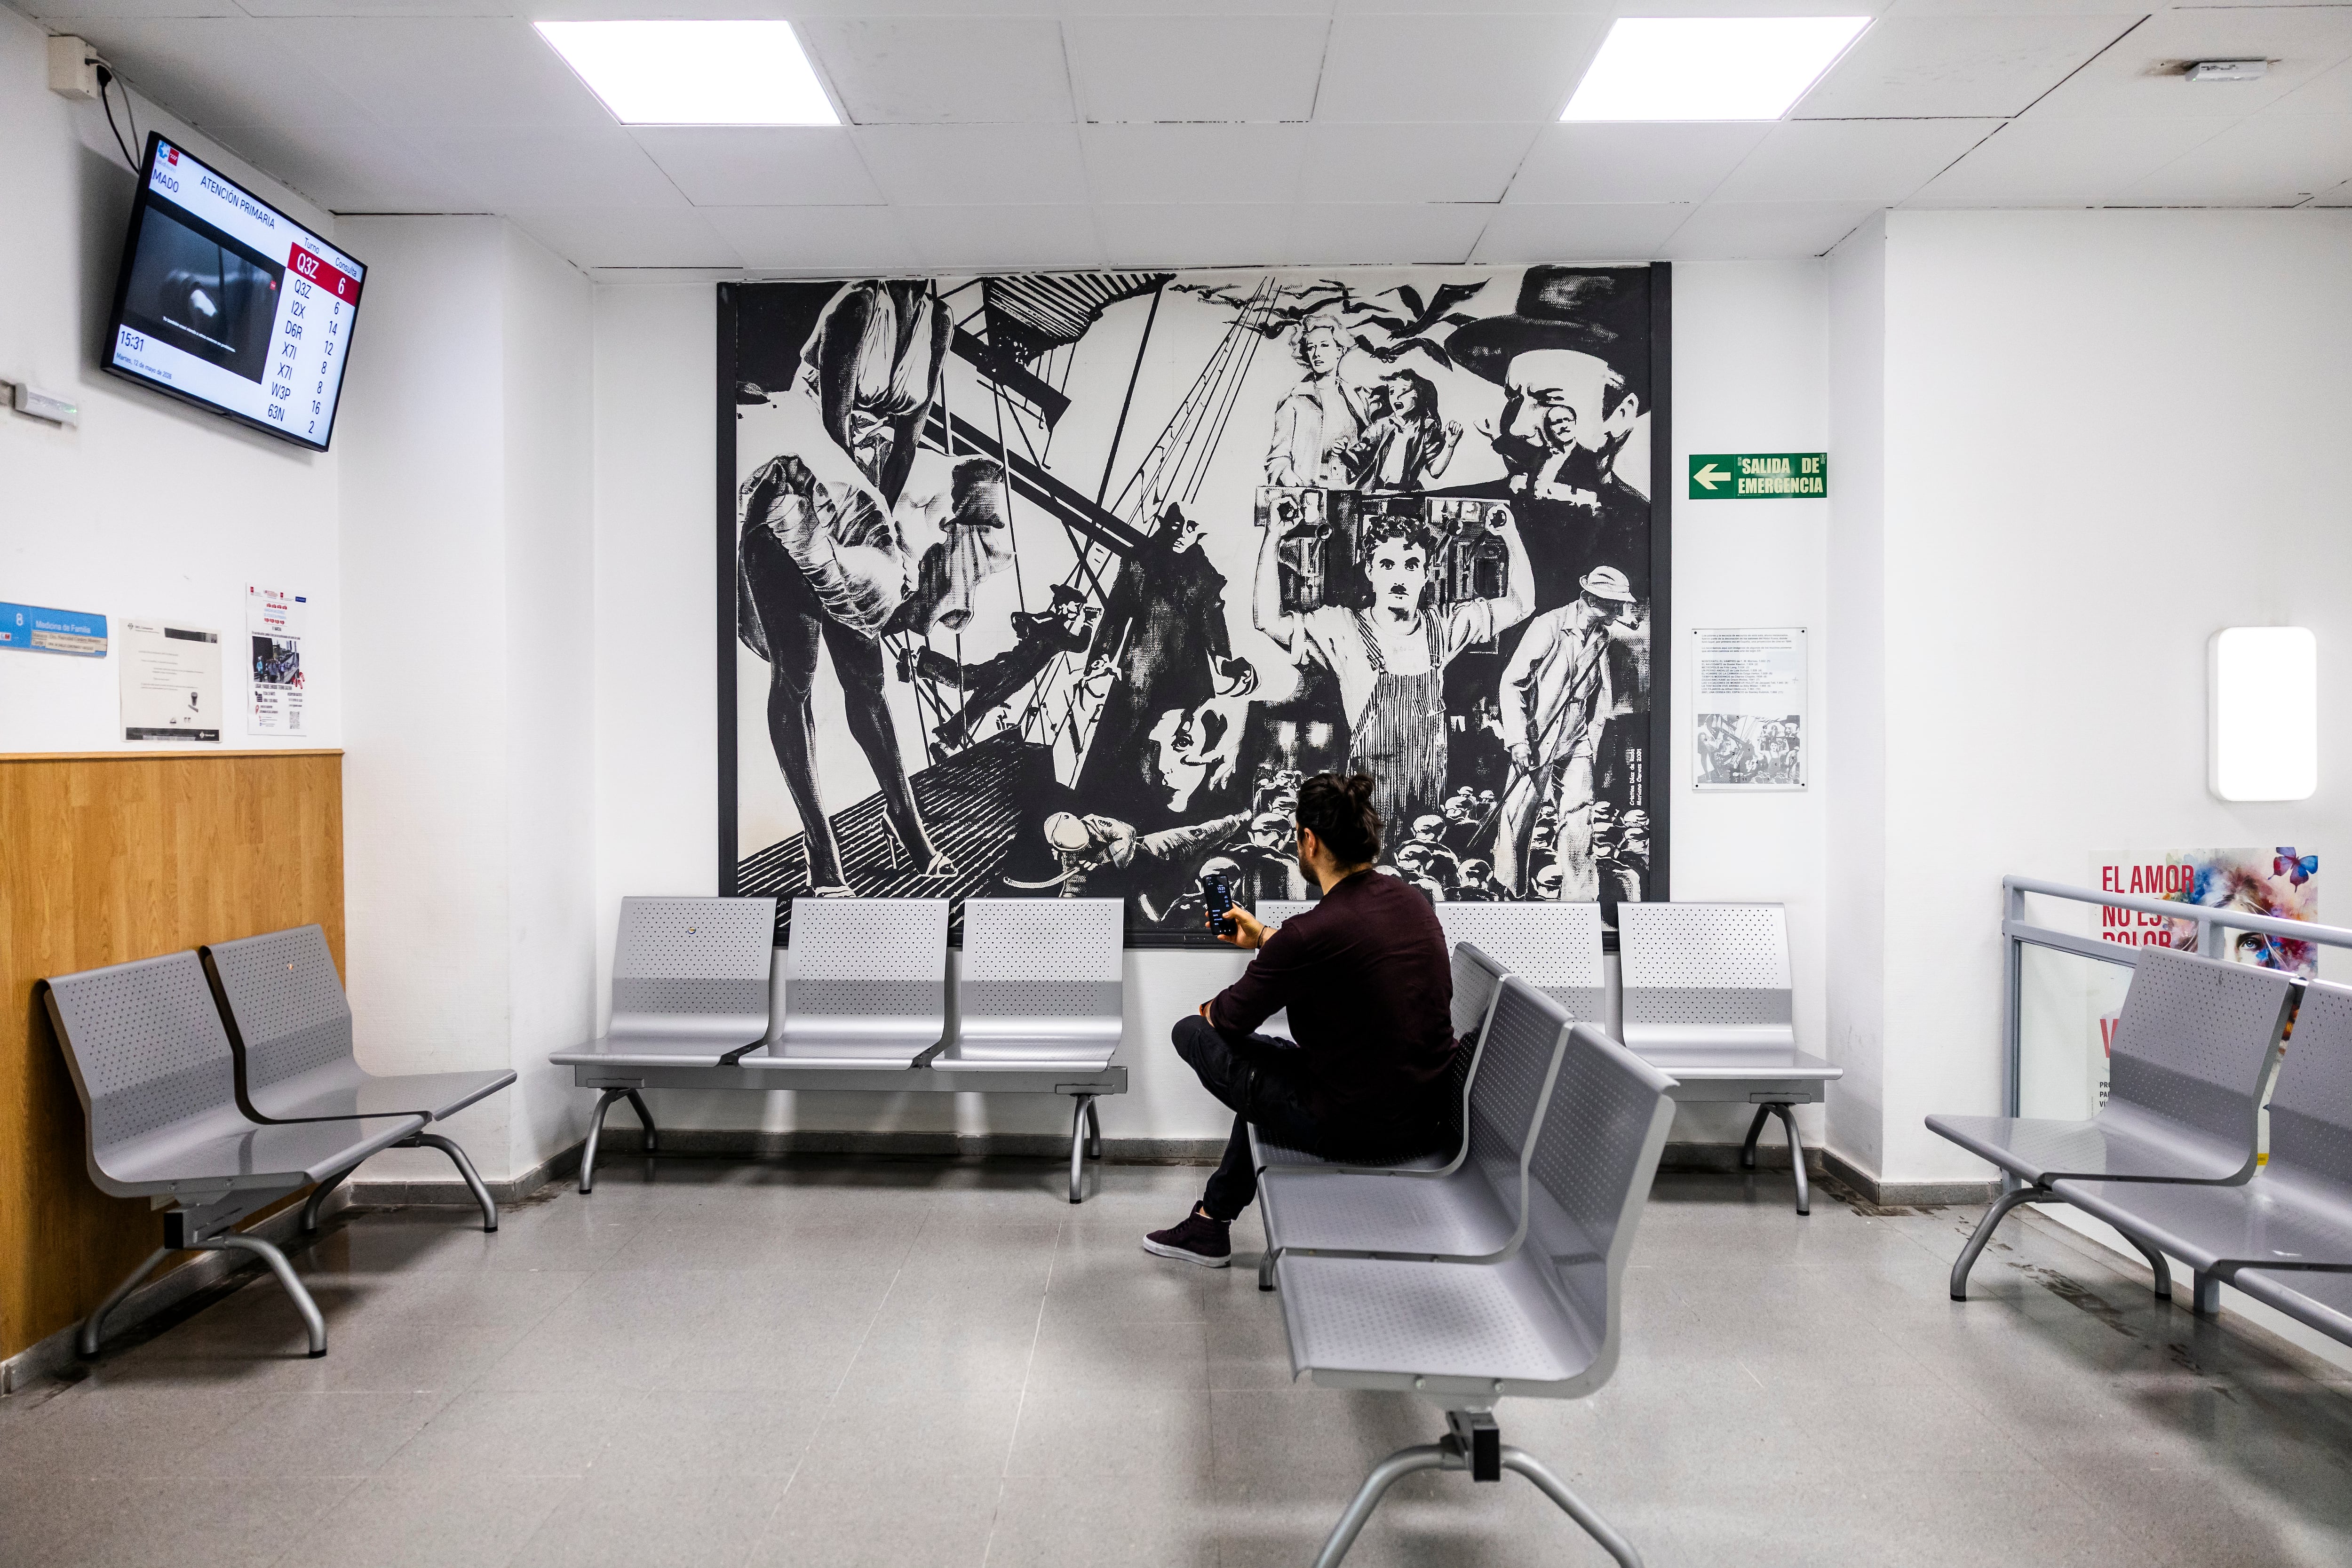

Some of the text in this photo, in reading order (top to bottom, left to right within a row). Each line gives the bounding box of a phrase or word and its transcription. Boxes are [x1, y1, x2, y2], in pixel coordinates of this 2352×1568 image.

[152, 169, 179, 192] MADO
[200, 176, 275, 230] ATENCIÓN PRIMARIA
[305, 237, 357, 277] Turno Consulta
[297, 253, 346, 294] Q3Z 6
[294, 279, 340, 315] Q3Z 6
[285, 320, 333, 356] D6R 12
[329, 320, 337, 335] 14
[120, 331, 144, 352] 15:31
[116, 352, 132, 365] Martes,
[145, 365, 156, 374] mayo
[321, 361, 327, 374] 8
[271, 382, 321, 414] W3P 16
[317, 381, 323, 394] 8
[268, 404, 314, 434] 63N 2
[1742, 458, 1820, 474] SALIDA DE
[1738, 477, 1823, 493] EMERGENCIA
[16, 613, 23, 626] 8
[2103, 865, 2194, 893] EL AMOR
[2103, 905, 2130, 927] NO
